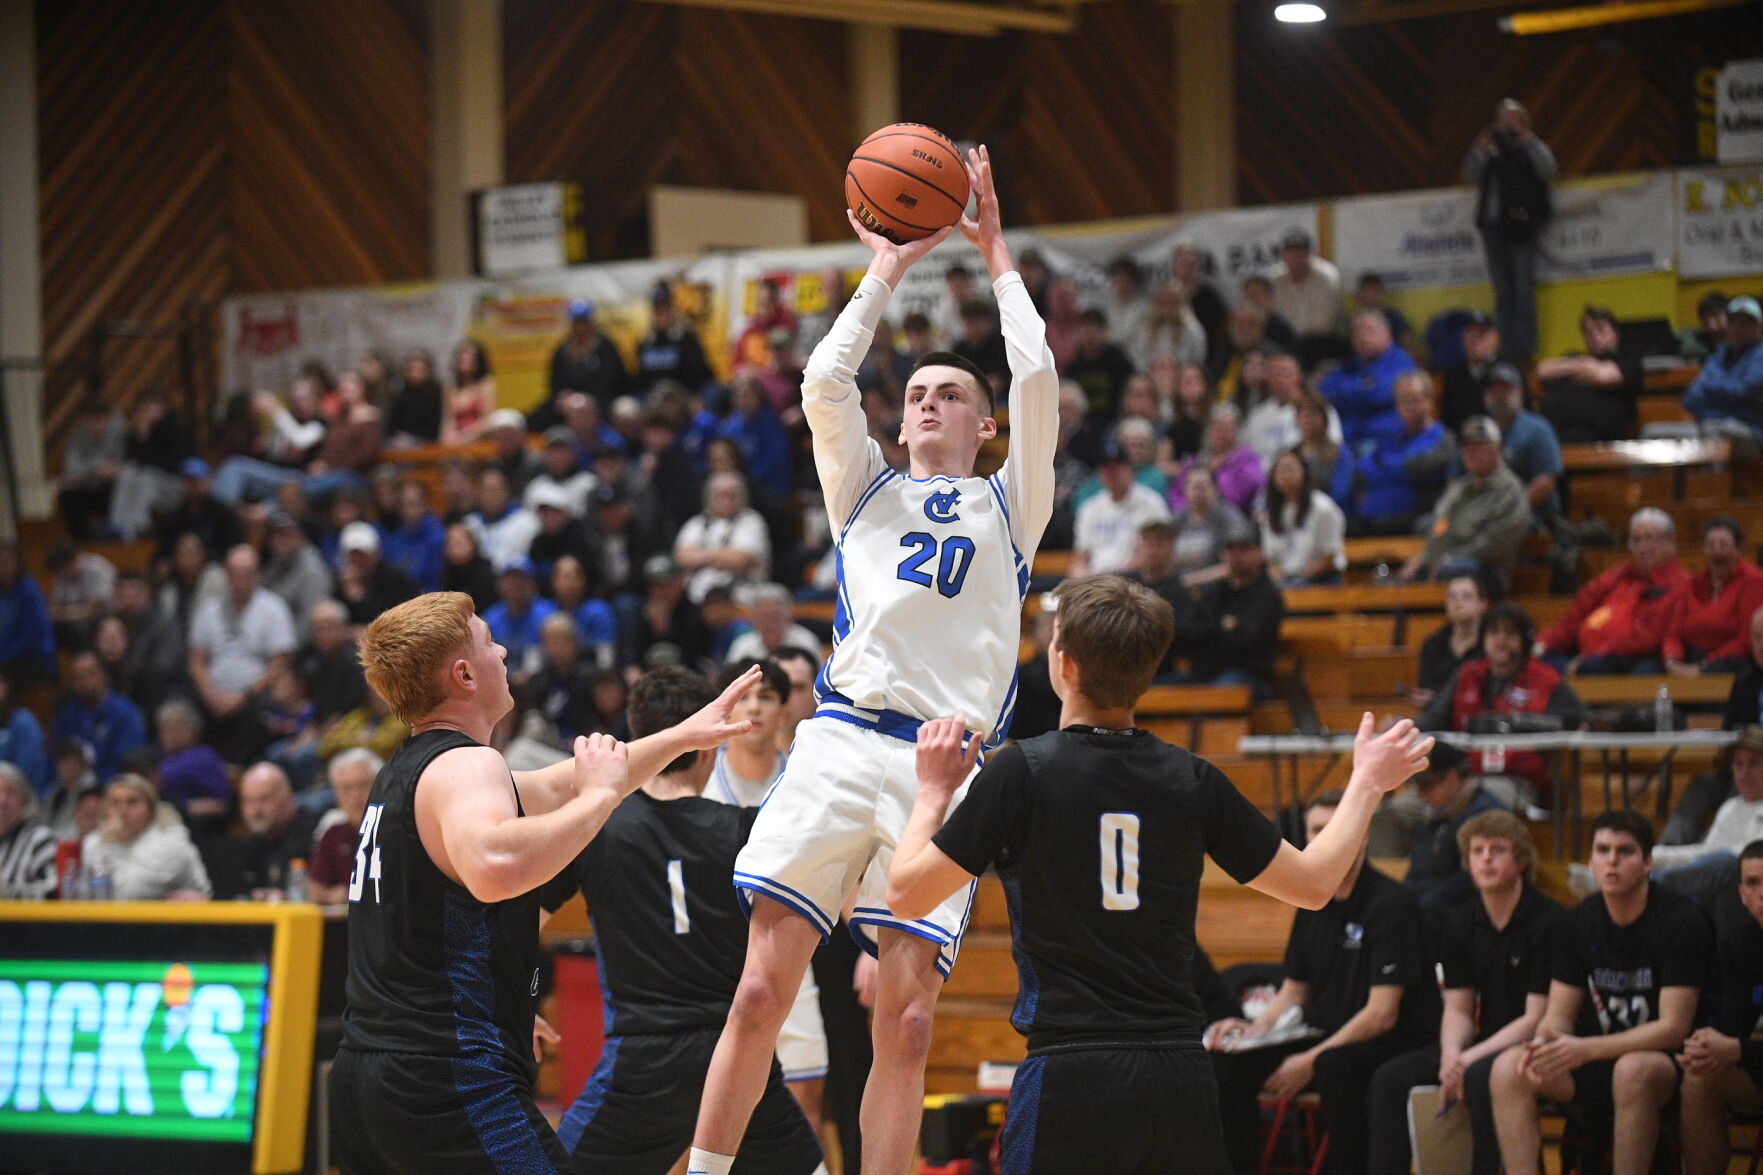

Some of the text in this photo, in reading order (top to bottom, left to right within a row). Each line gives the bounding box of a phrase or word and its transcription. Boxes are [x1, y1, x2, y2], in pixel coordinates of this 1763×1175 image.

[897, 531, 976, 599] 20
[348, 803, 385, 905] 34
[666, 858, 690, 935] 1
[1099, 810, 1142, 912] 0
